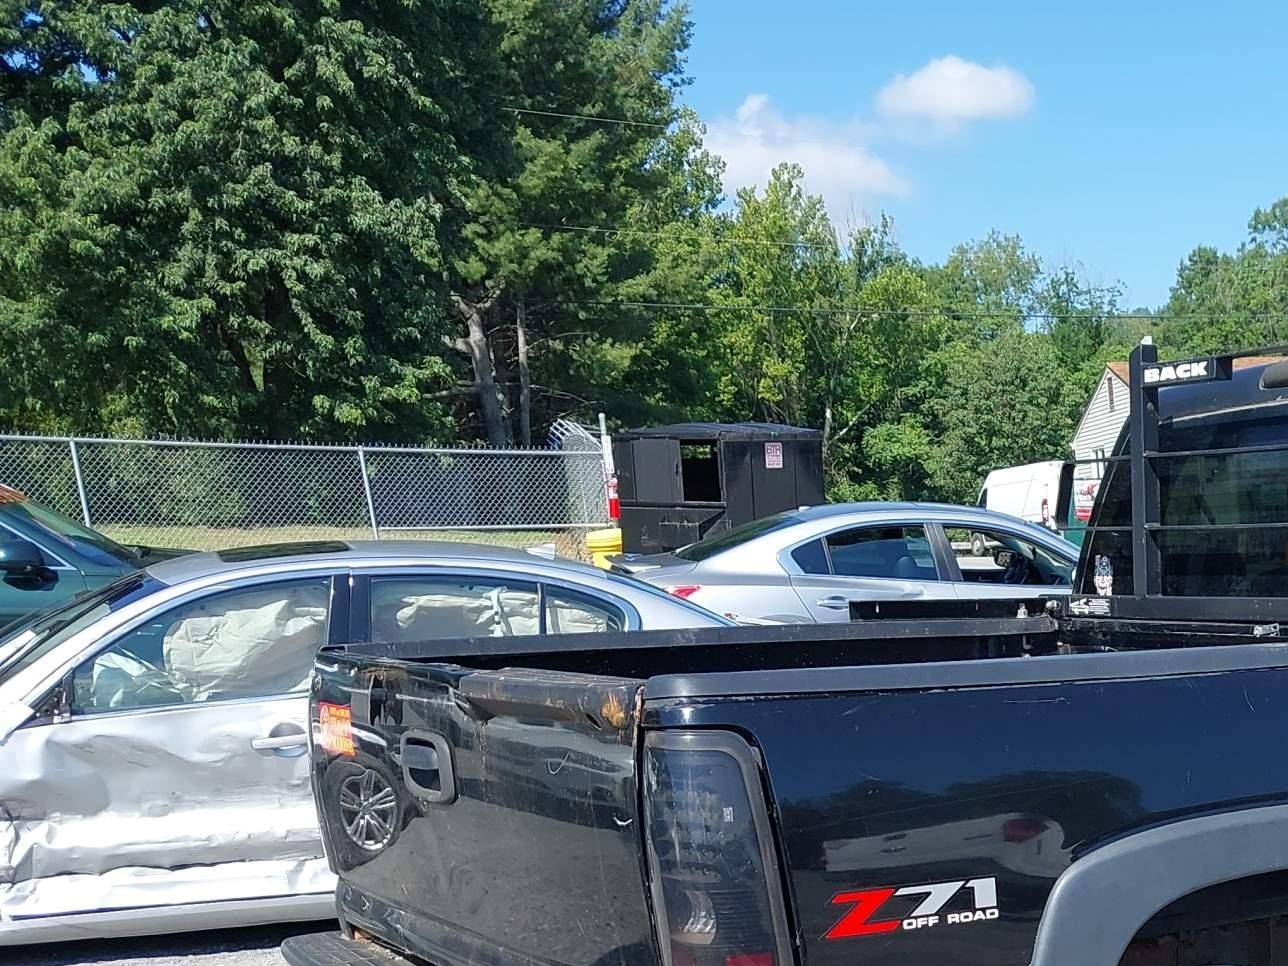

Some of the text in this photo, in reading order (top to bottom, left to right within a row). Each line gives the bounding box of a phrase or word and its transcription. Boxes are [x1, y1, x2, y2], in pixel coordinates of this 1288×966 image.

[1143, 361, 1208, 384] BACK
[826, 877, 998, 940] Z71
[902, 909, 999, 930] OFF ROAD
